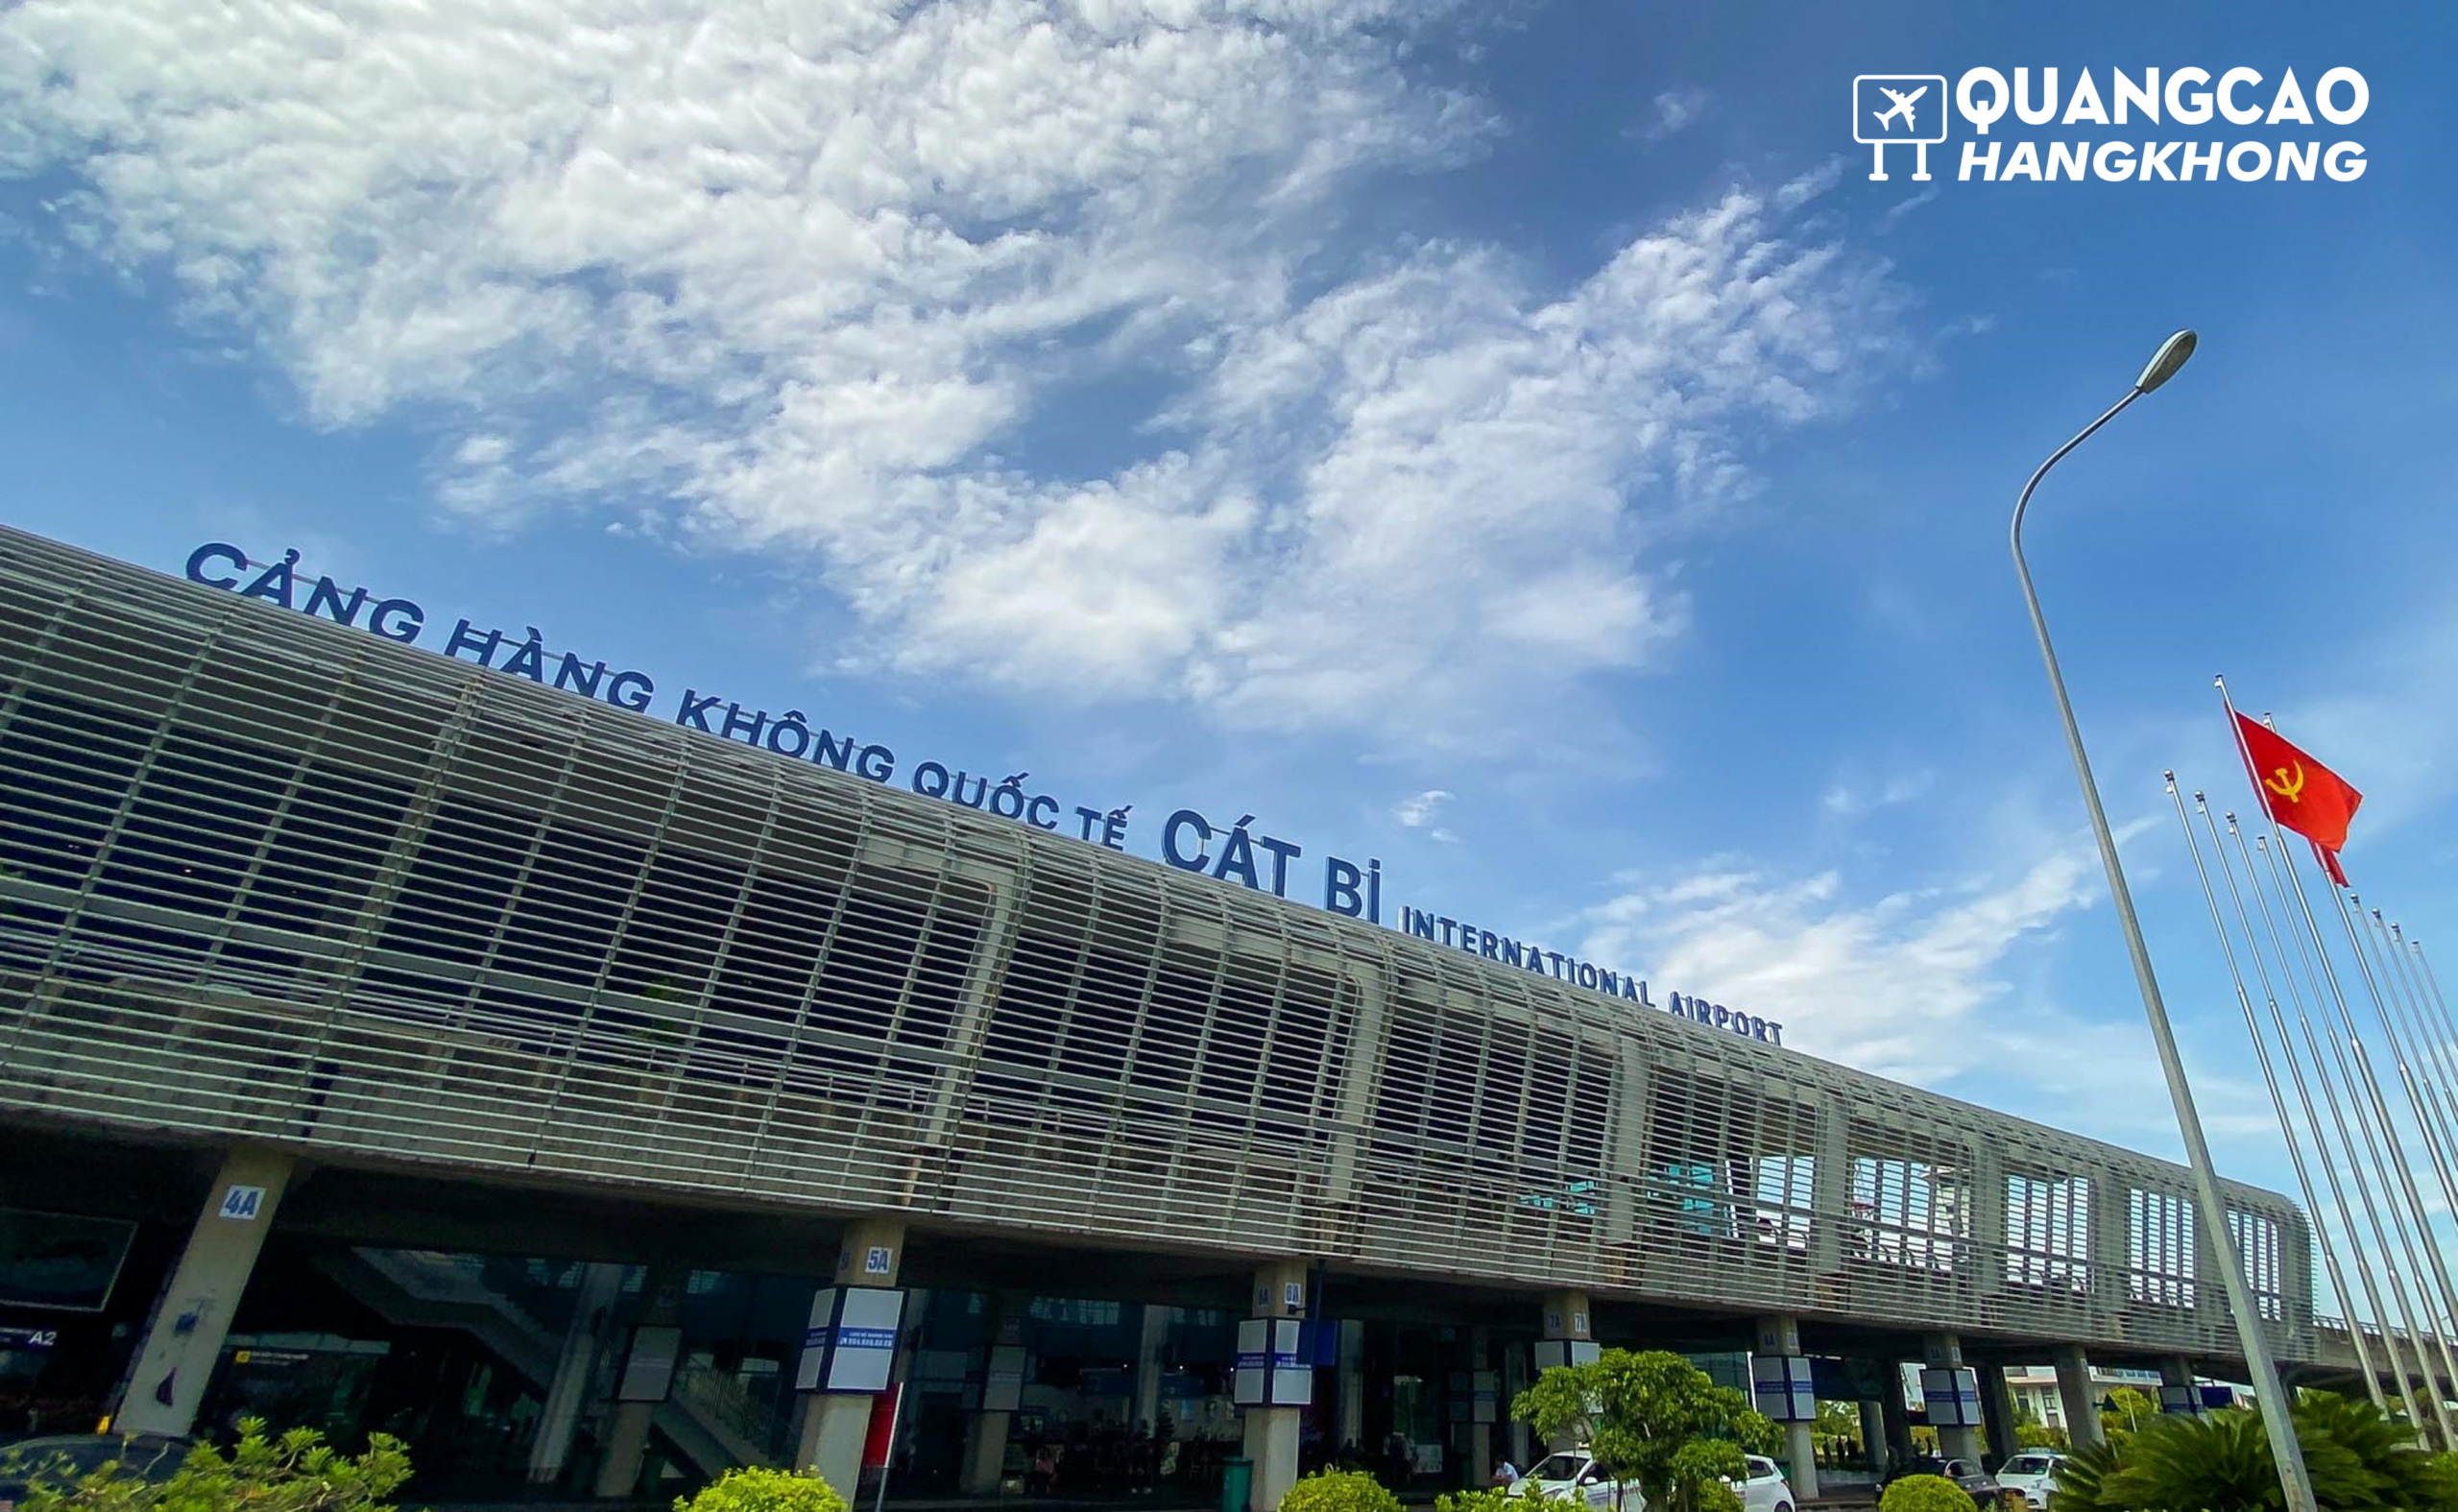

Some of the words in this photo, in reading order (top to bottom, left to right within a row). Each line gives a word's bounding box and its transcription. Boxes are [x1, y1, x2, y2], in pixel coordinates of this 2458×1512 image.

[185, 542, 425, 645] CẢNG
[445, 618, 655, 714] HÀNG
[676, 688, 895, 783] KHÔNG
[912, 761, 1060, 830] QUỐC
[1074, 804, 1133, 852] TẾ
[1162, 809, 1301, 899] CÁT
[1400, 905, 1655, 1008] INTERNATIONAL
[1667, 989, 1783, 1046] AIRPORT
[226, 1189, 258, 1215] 4A
[868, 1250, 888, 1271] 5A
[28, 1331, 58, 1345] A2
